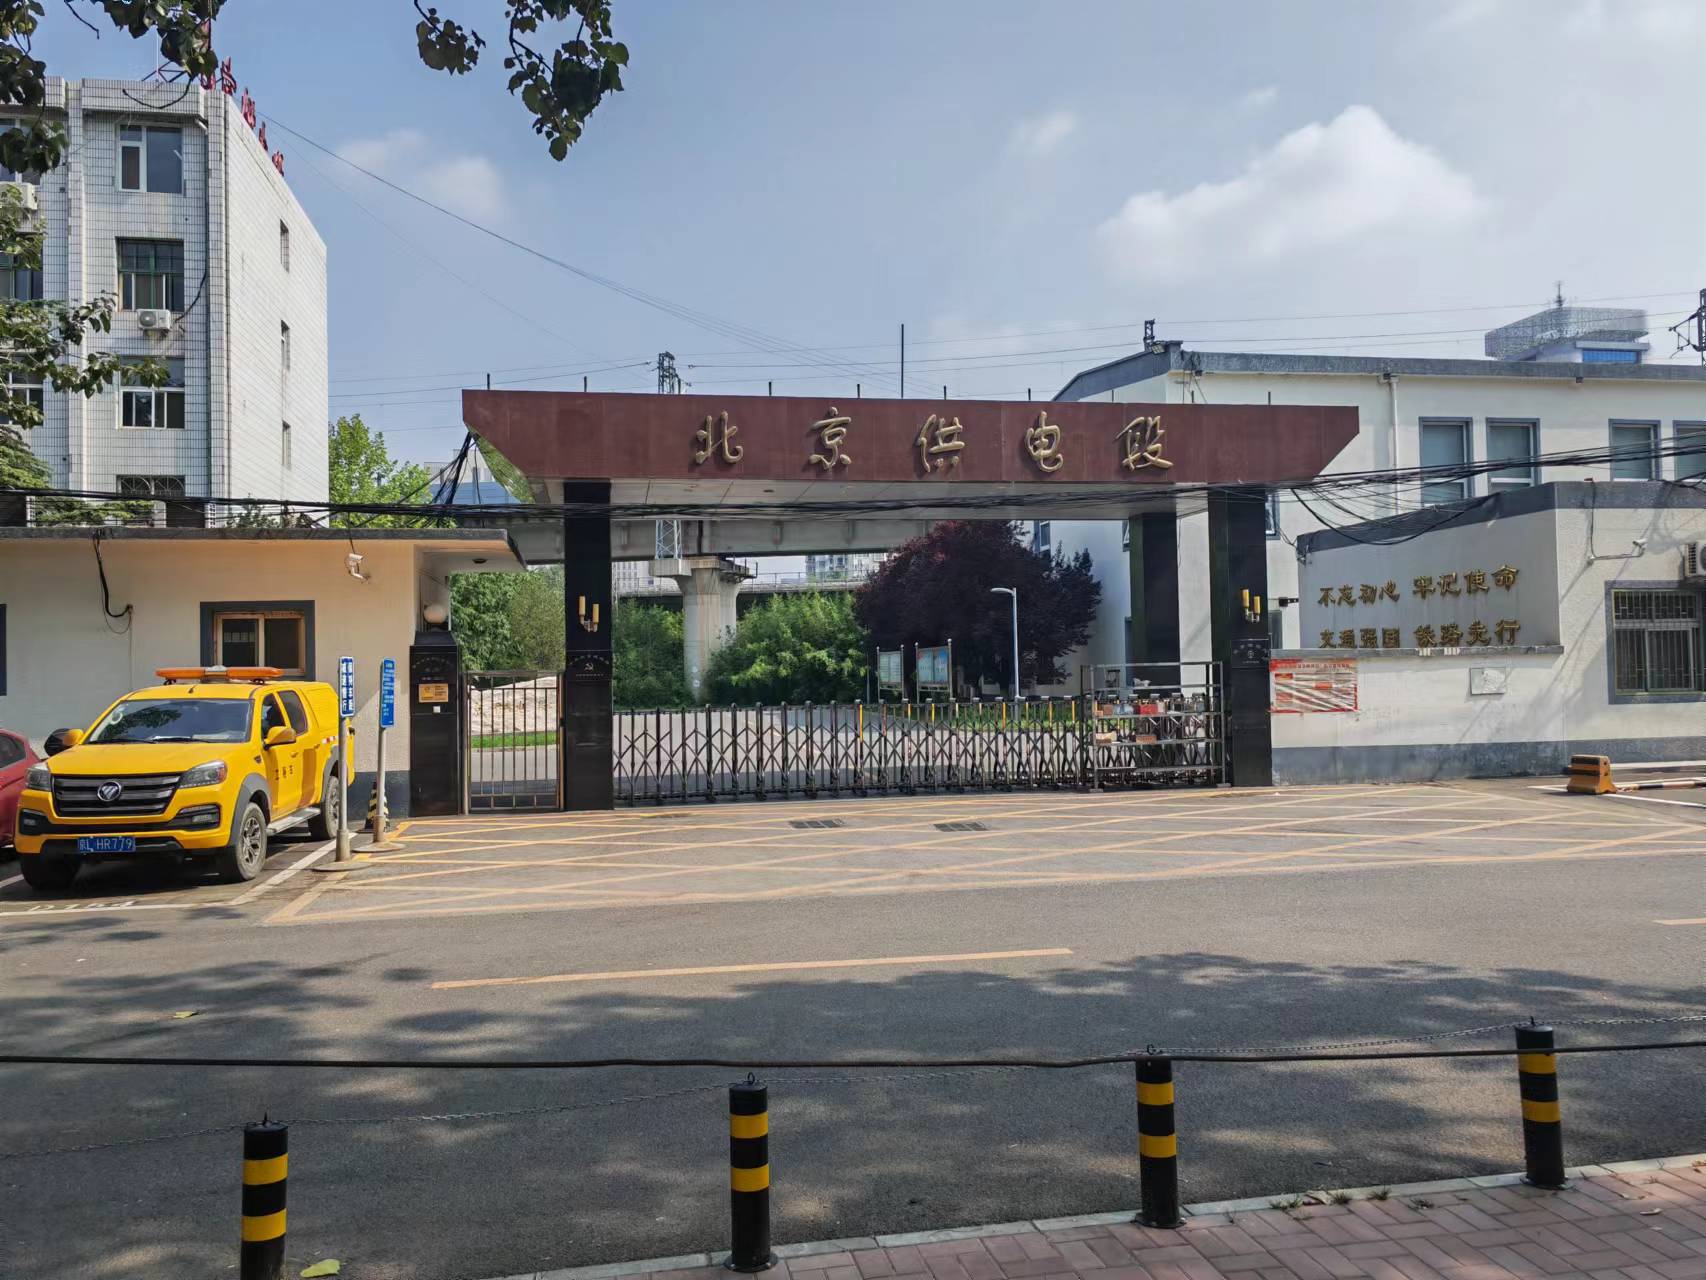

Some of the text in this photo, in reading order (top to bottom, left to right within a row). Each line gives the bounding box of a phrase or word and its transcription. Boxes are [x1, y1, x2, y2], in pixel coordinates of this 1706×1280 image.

[695, 406, 1174, 473] 北京供电段
[1317, 564, 1520, 607] 不忘初心 牢记使命
[1413, 618, 1521, 648] 铁路先行
